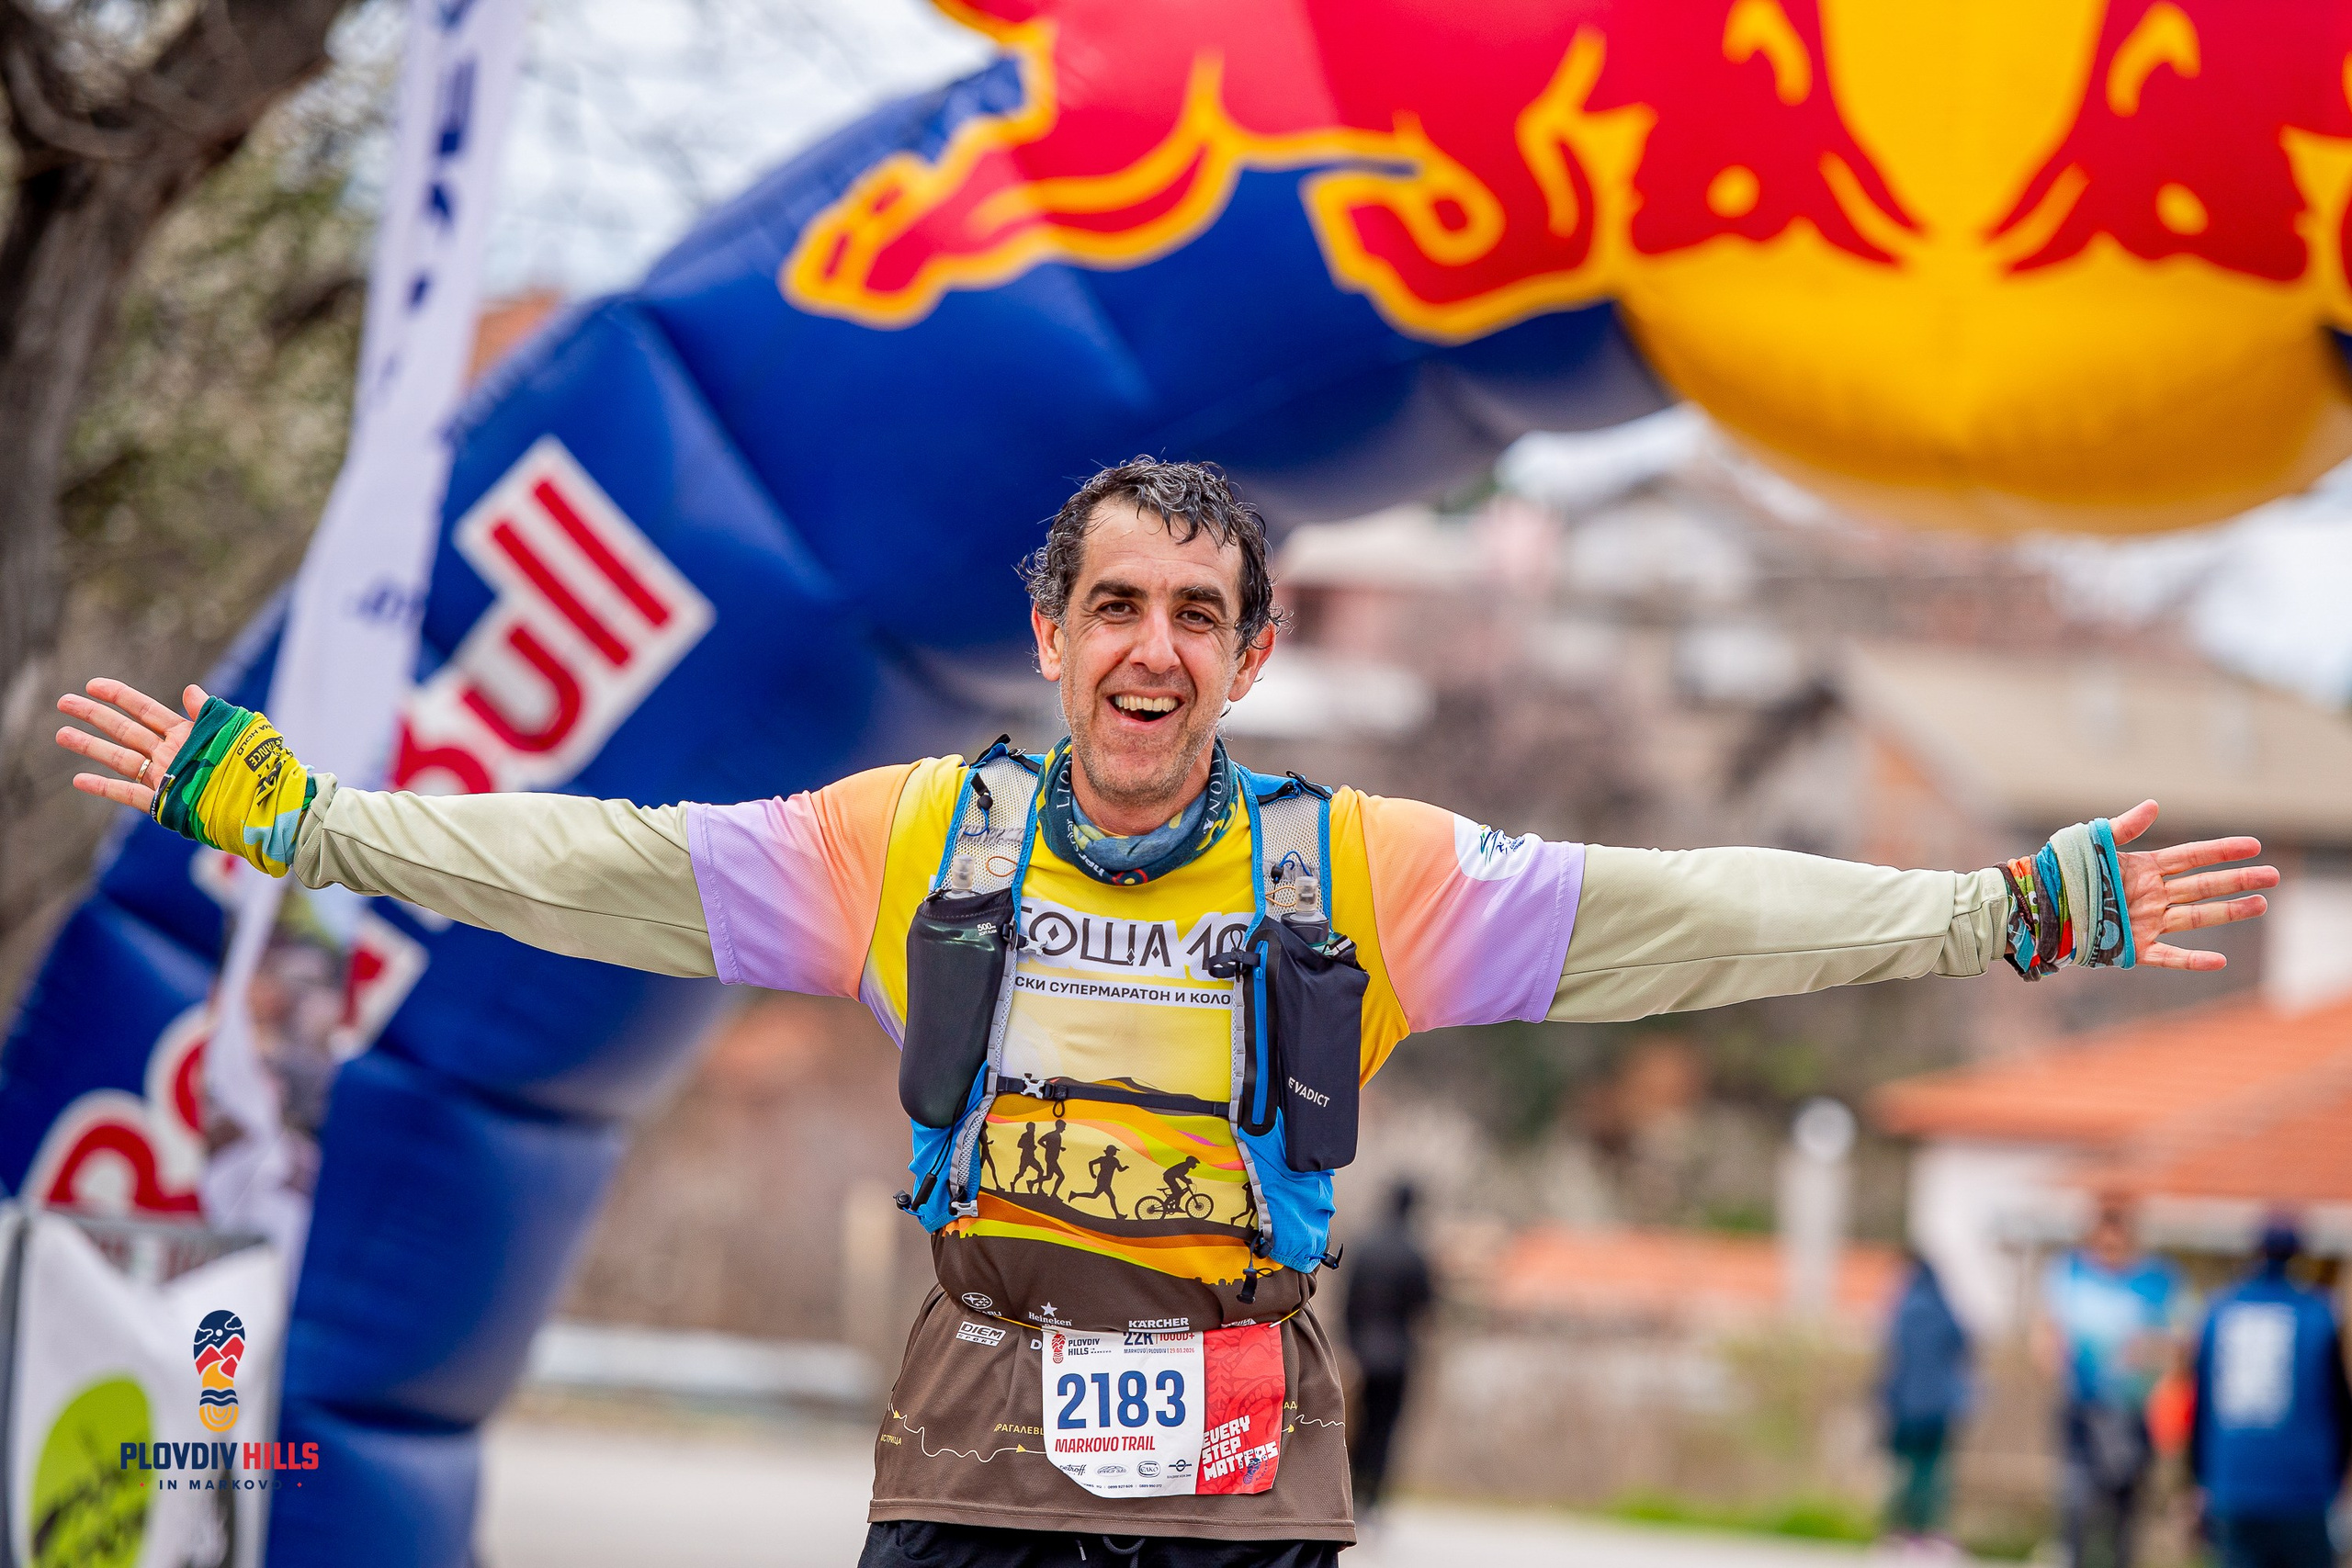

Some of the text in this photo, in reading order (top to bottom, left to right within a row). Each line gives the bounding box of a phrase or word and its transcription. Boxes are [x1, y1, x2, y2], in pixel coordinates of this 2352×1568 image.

[1049, 981, 1170, 1002] СУПЕРМАРАТОН
[1175, 991, 1185, 1002] И
[1288, 1077, 1330, 1108] EVADICT
[1028, 1311, 1072, 1326] Heineken
[1128, 1317, 1190, 1329] KÄRCHER
[957, 1333, 997, 1345] SPORT
[960, 1323, 1004, 1339] DIEM
[1068, 1337, 1101, 1347] PLOVDIV
[1068, 1348, 1089, 1356] HILLS
[1056, 1370, 1186, 1431] 2183
[1203, 1415, 1250, 1449] EVERY
[1055, 1436, 1156, 1453] MARKOVO TRAIL
[1202, 1436, 1241, 1465] STEP
[1203, 1441, 1279, 1482] MATTERS
